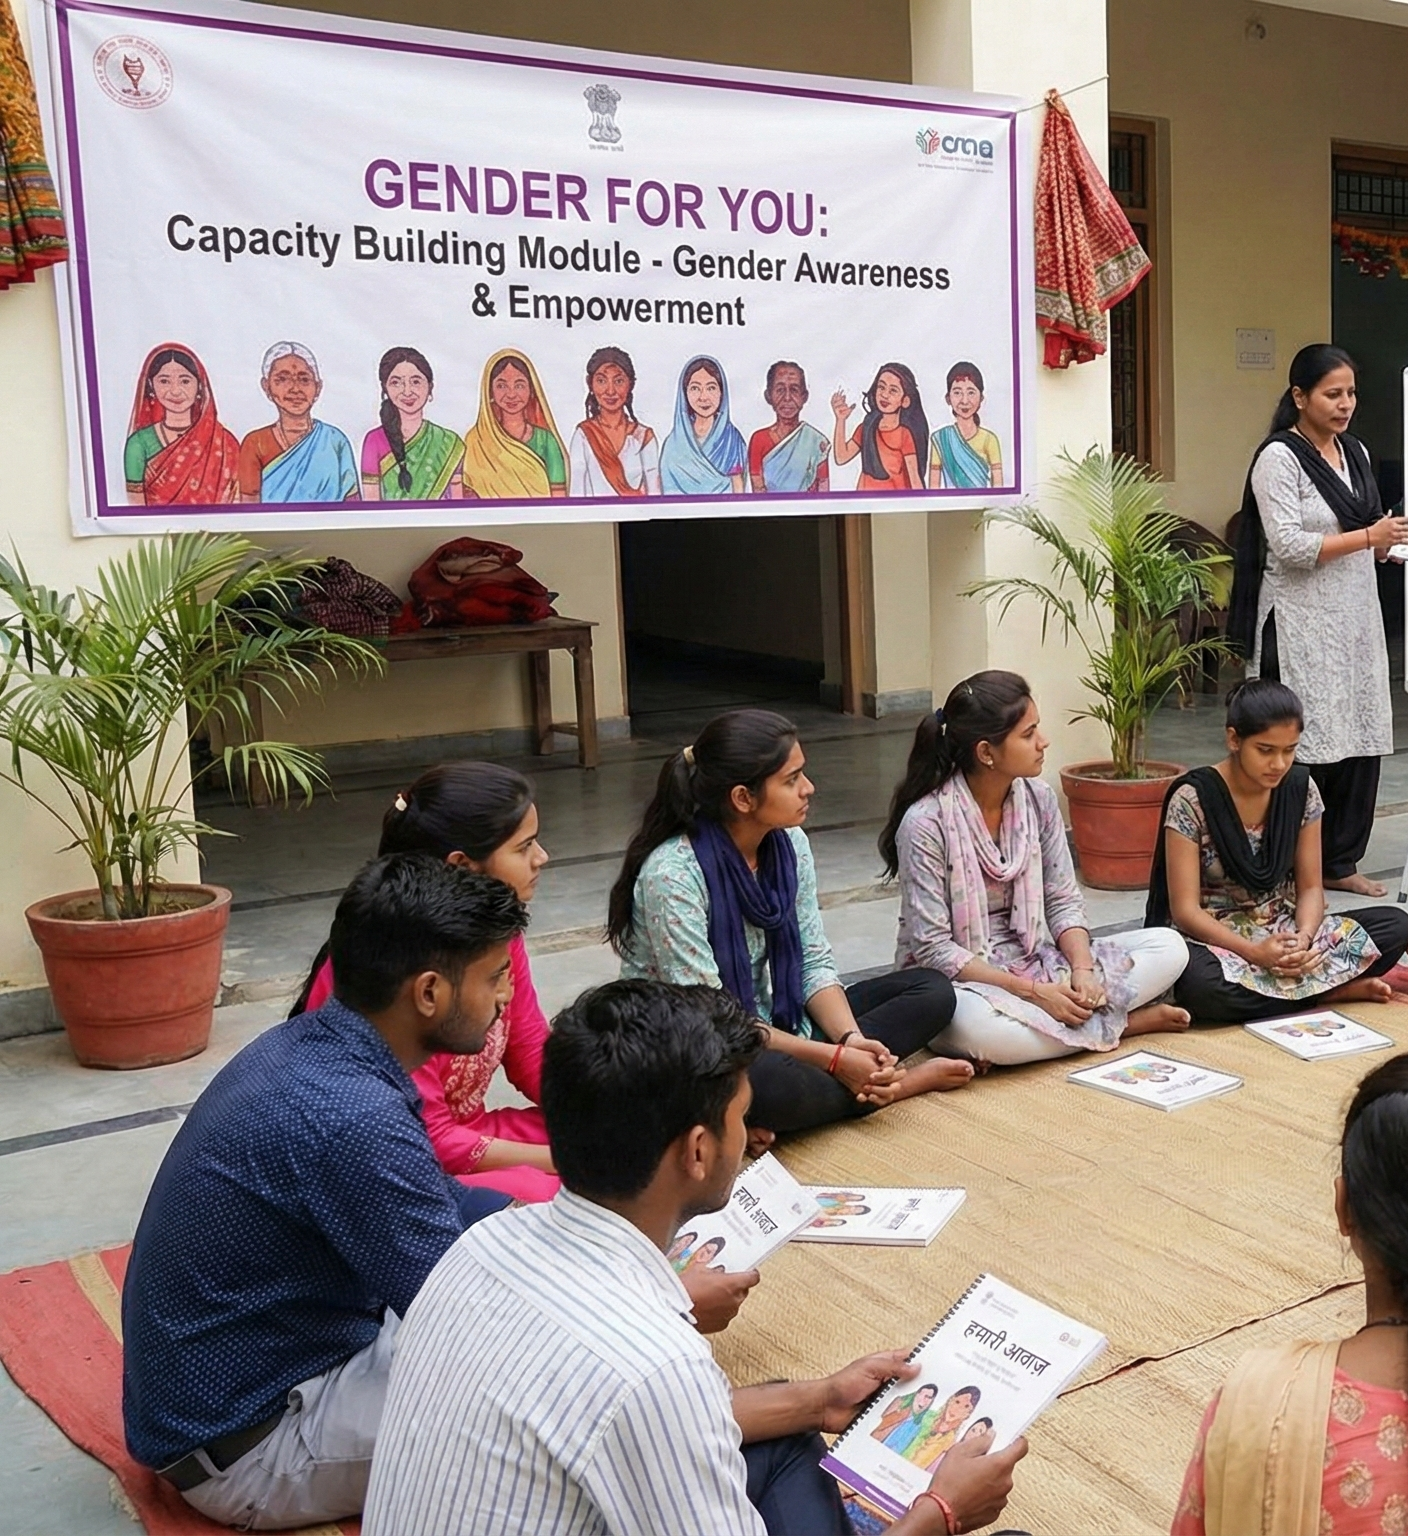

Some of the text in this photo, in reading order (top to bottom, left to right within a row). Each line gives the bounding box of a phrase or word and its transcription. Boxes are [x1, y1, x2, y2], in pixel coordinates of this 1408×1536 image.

[364, 158, 829, 238] GENDER FOR YOU:
[167, 214, 341, 268] Capacity
[353, 224, 506, 276] Building
[518, 235, 641, 274] Module
[673, 244, 787, 282] Gender
[794, 252, 950, 290] Awareness
[471, 282, 746, 331] & Empowerment
[963, 1319, 1008, 1351] हमारी
[1004, 1342, 1052, 1378] आवाज़
